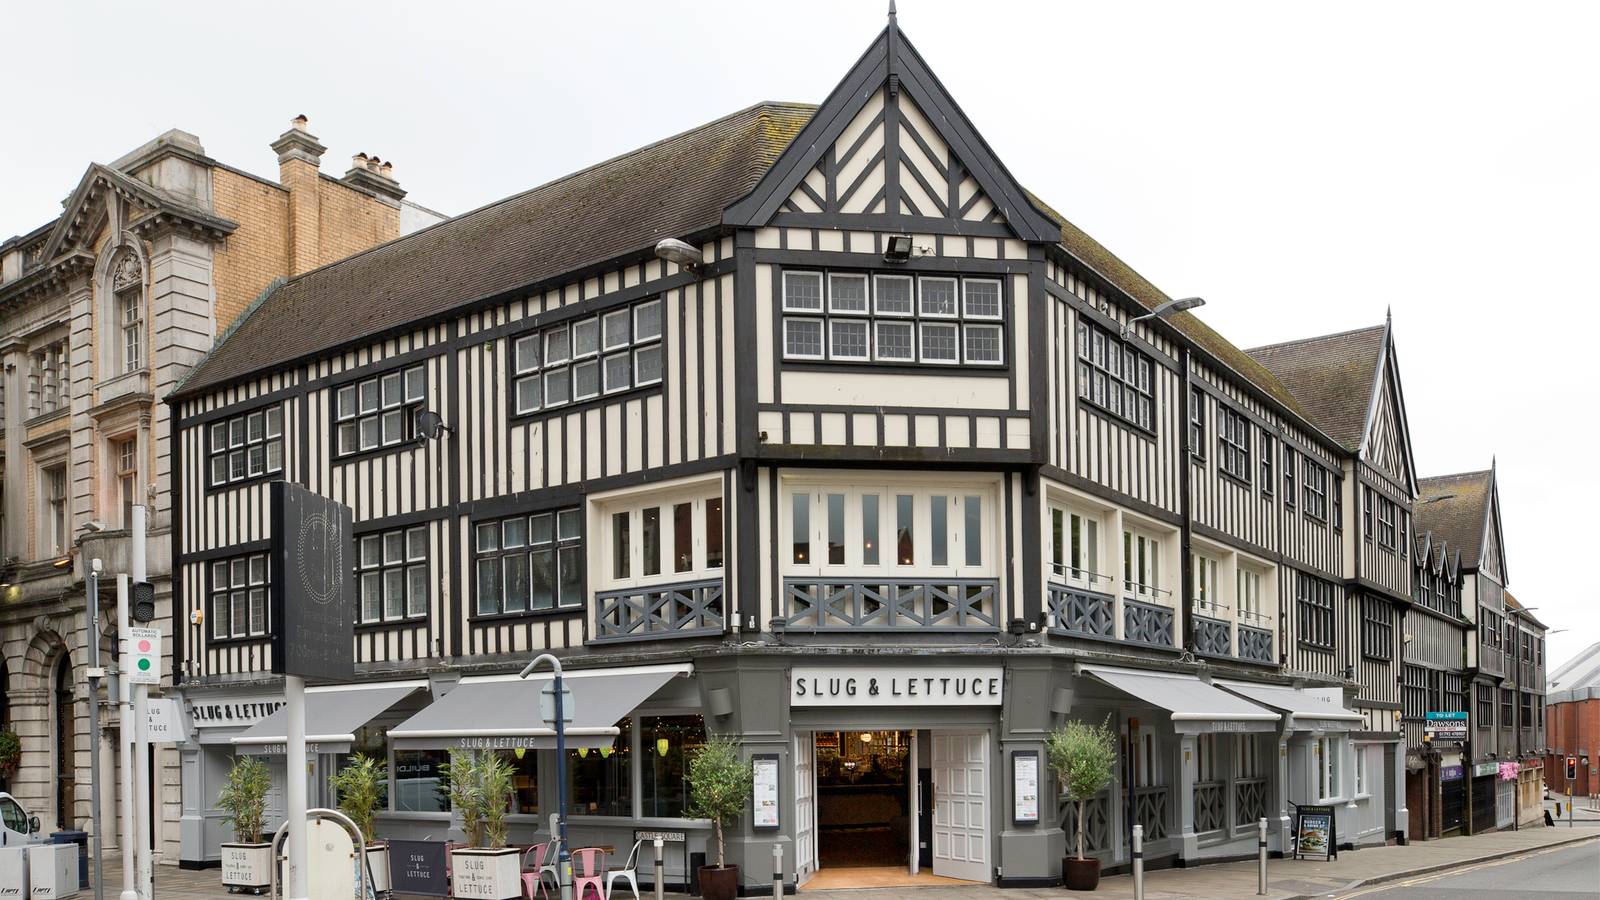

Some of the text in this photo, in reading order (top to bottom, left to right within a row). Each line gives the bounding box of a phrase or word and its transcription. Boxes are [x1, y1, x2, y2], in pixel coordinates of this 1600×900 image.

[796, 677, 999, 696] SLUG & LETTUCE
[192, 701, 287, 720] SLUG & LETTUC
[1426, 719, 1465, 728] Dawsons
[461, 737, 535, 748] SLUG & LETTUCE
[264, 744, 280, 753] SLUG
[231, 852, 247, 860] SLUG
[410, 854, 424, 862] SLUG
[465, 861, 484, 870] SLUG
[226, 871, 252, 881] LETTUCE
[406, 870, 431, 879] LETTUCE
[471, 873, 476, 882] &
[459, 884, 493, 895] LETTUCE
